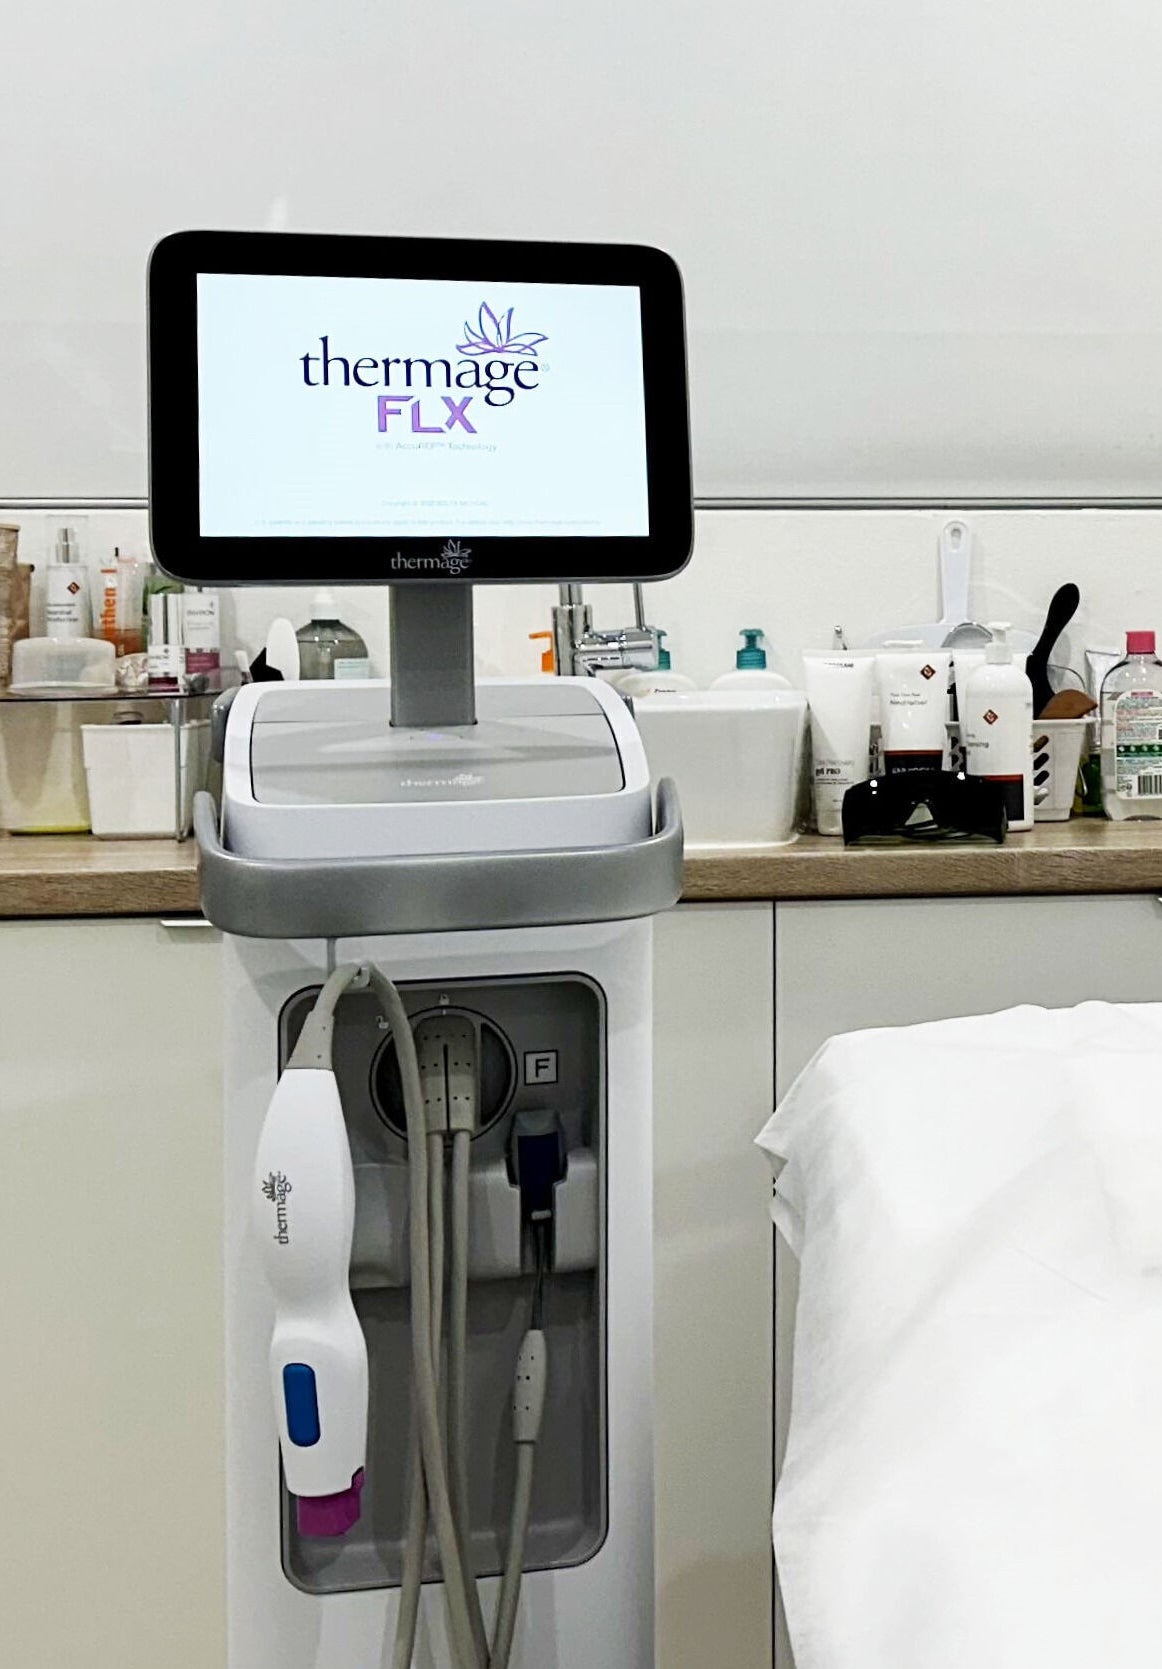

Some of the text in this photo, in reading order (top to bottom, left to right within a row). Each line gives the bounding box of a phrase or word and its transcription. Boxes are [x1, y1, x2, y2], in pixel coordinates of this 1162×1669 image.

[299, 335, 540, 407] thermage
[377, 395, 478, 434] FLX
[391, 552, 470, 574] thermage
[535, 1058, 550, 1078] F
[273, 1169, 292, 1245] thermage
